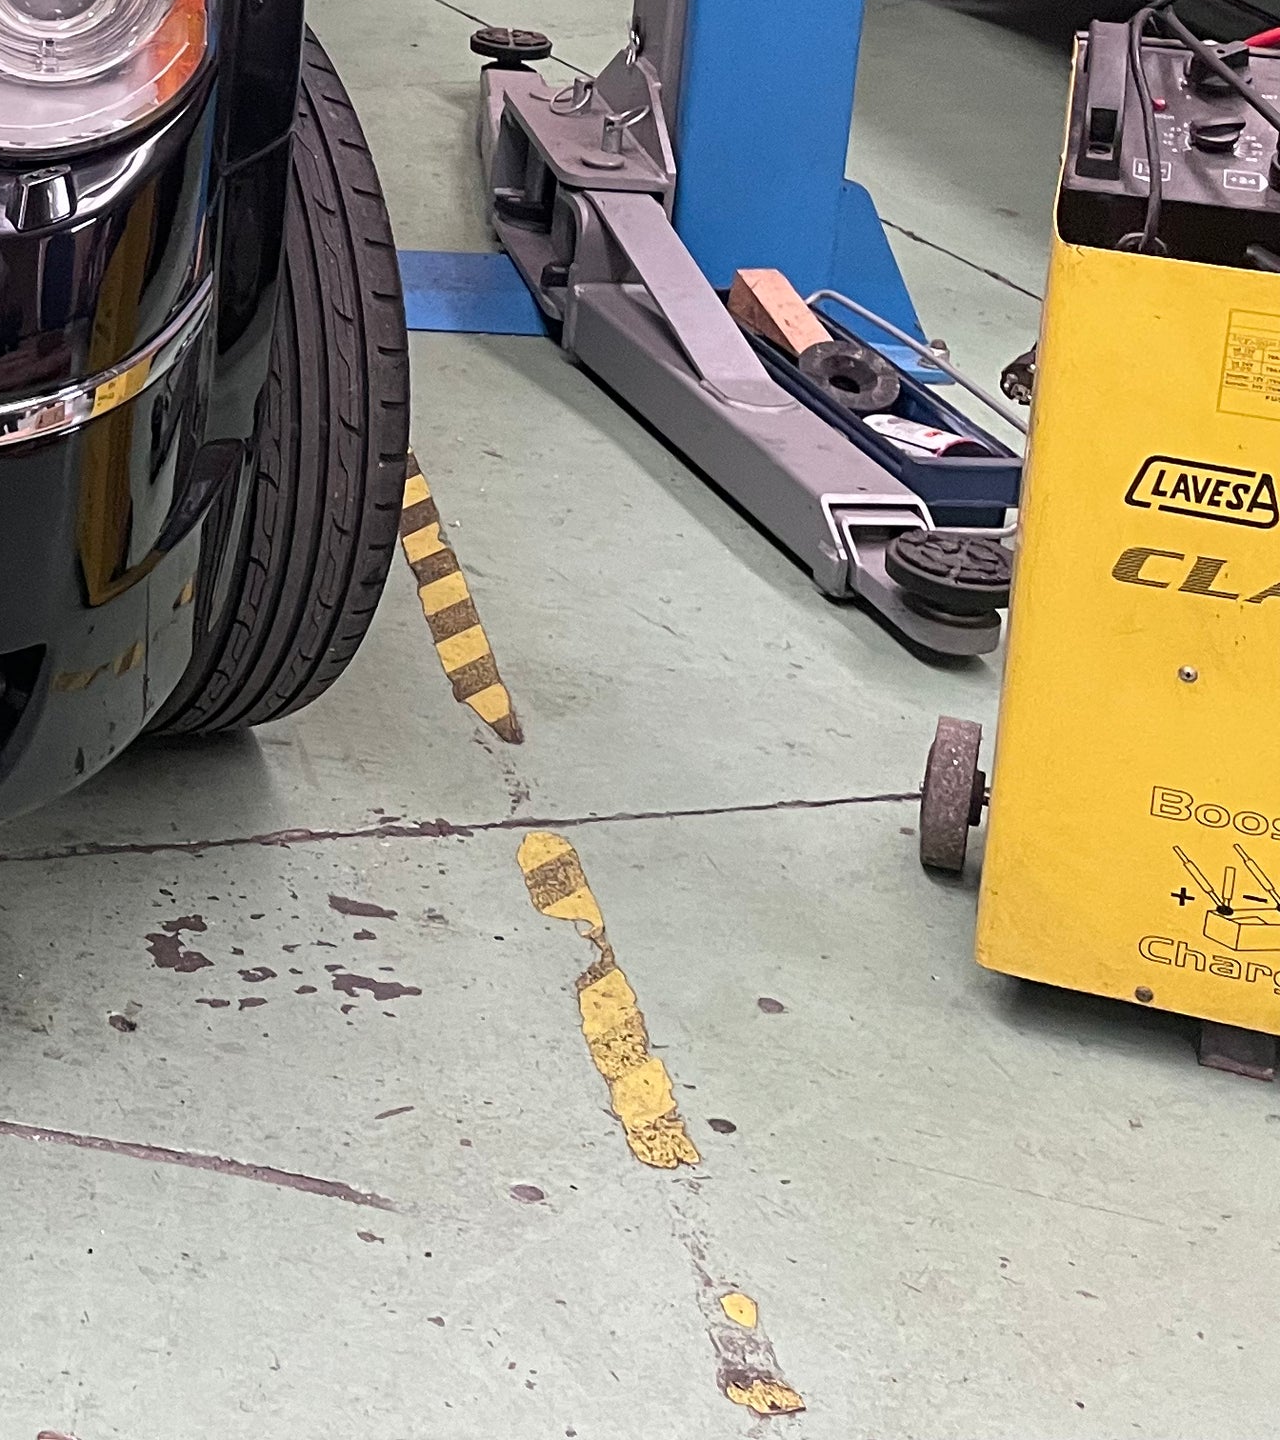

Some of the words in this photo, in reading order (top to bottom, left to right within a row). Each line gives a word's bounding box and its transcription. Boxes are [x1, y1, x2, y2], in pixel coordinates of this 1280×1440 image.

[1150, 469, 1277, 513] LAVESA
[1150, 785, 1280, 841] Boo
[1138, 935, 1280, 996] Char
